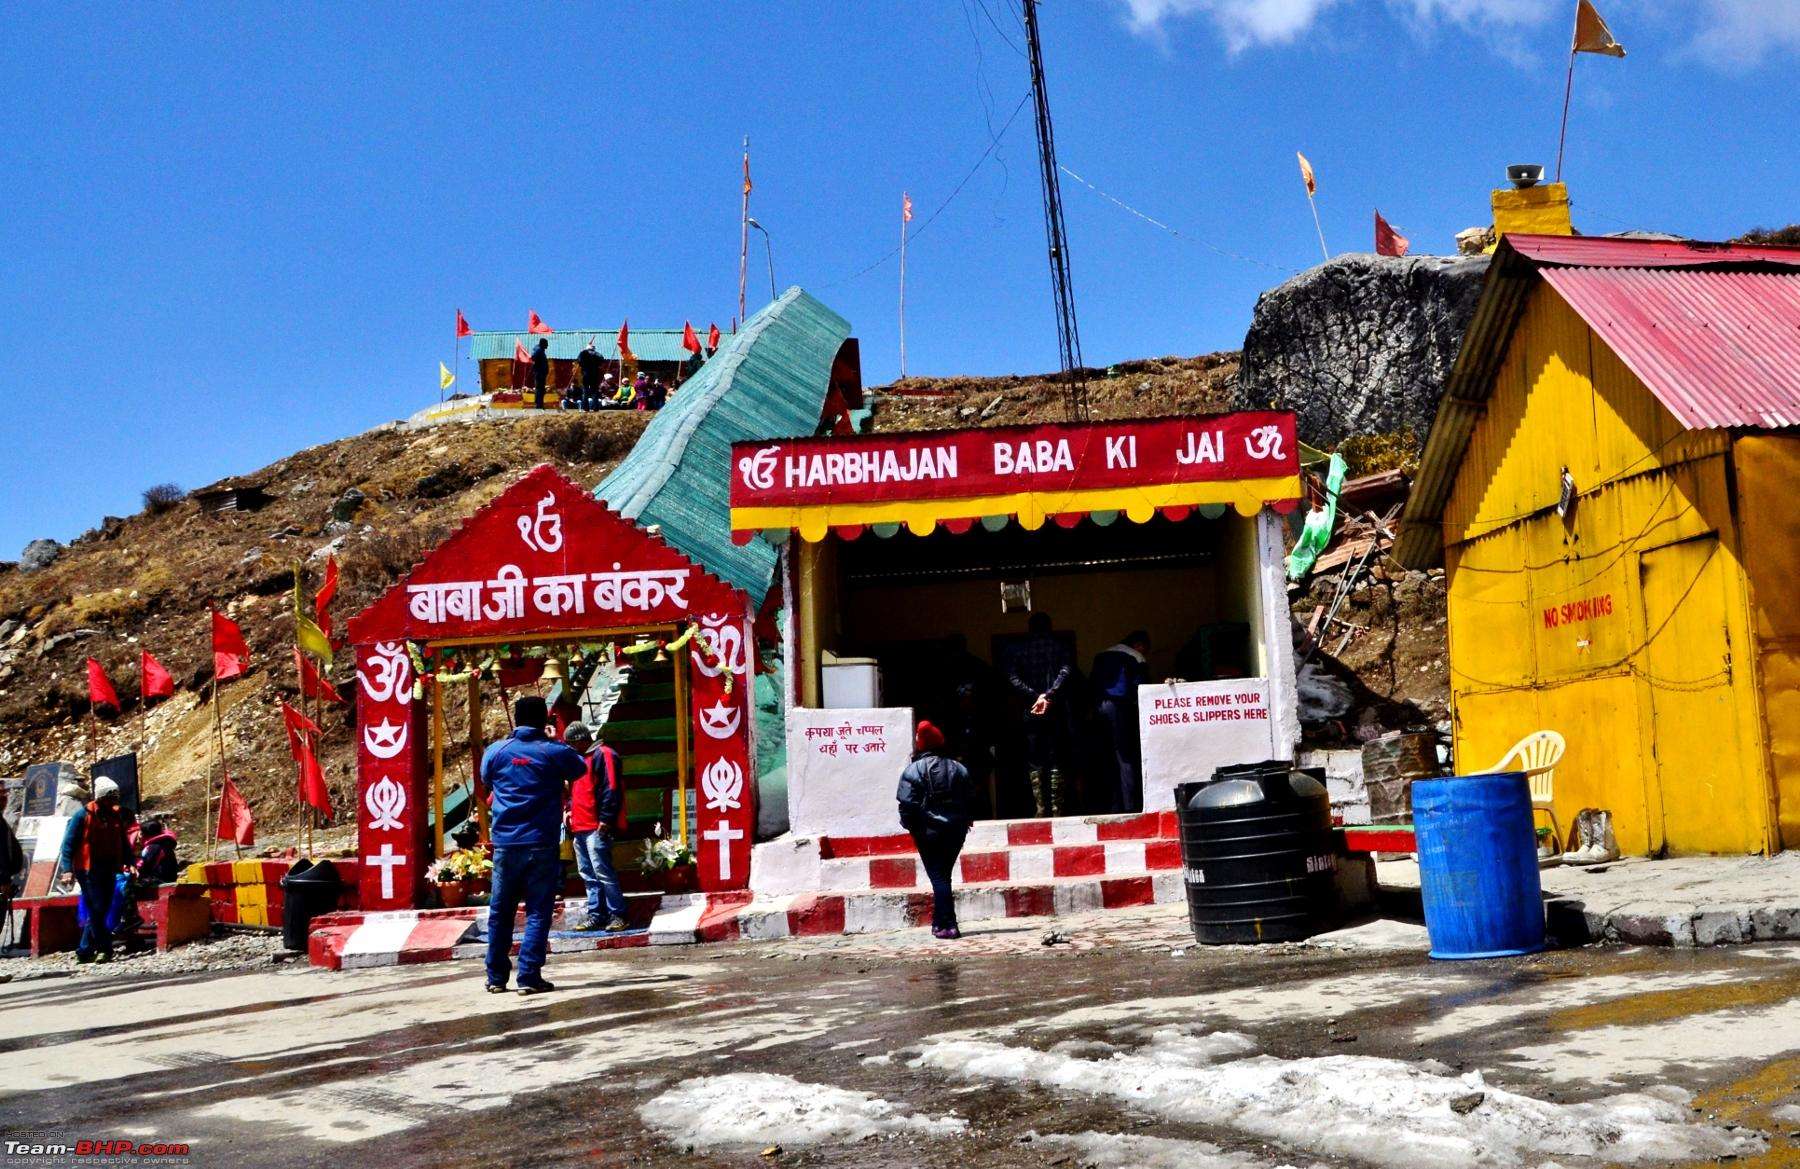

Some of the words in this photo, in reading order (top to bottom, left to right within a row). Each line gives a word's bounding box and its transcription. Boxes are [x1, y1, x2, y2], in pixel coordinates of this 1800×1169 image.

[785, 445, 958, 488] HARBHAJAN
[993, 438, 1075, 475] BABA
[1105, 435, 1137, 469] KI
[1176, 430, 1225, 464] JAI
[532, 573, 587, 616] का
[591, 562, 690, 612] बंकर
[1544, 607, 1559, 629] NO
[1561, 594, 1613, 624] SMOKING
[1155, 697, 1191, 709] PLEASE
[1195, 694, 1232, 706] REMOVE
[1235, 693, 1260, 704] YOUR
[1149, 713, 1180, 725] SHOES
[1182, 712, 1190, 723] &
[1193, 709, 1241, 722] SLIPPERS
[1244, 708, 1268, 720] HERE
[805, 727, 835, 740] कृपया
[844, 744, 858, 754] पर
